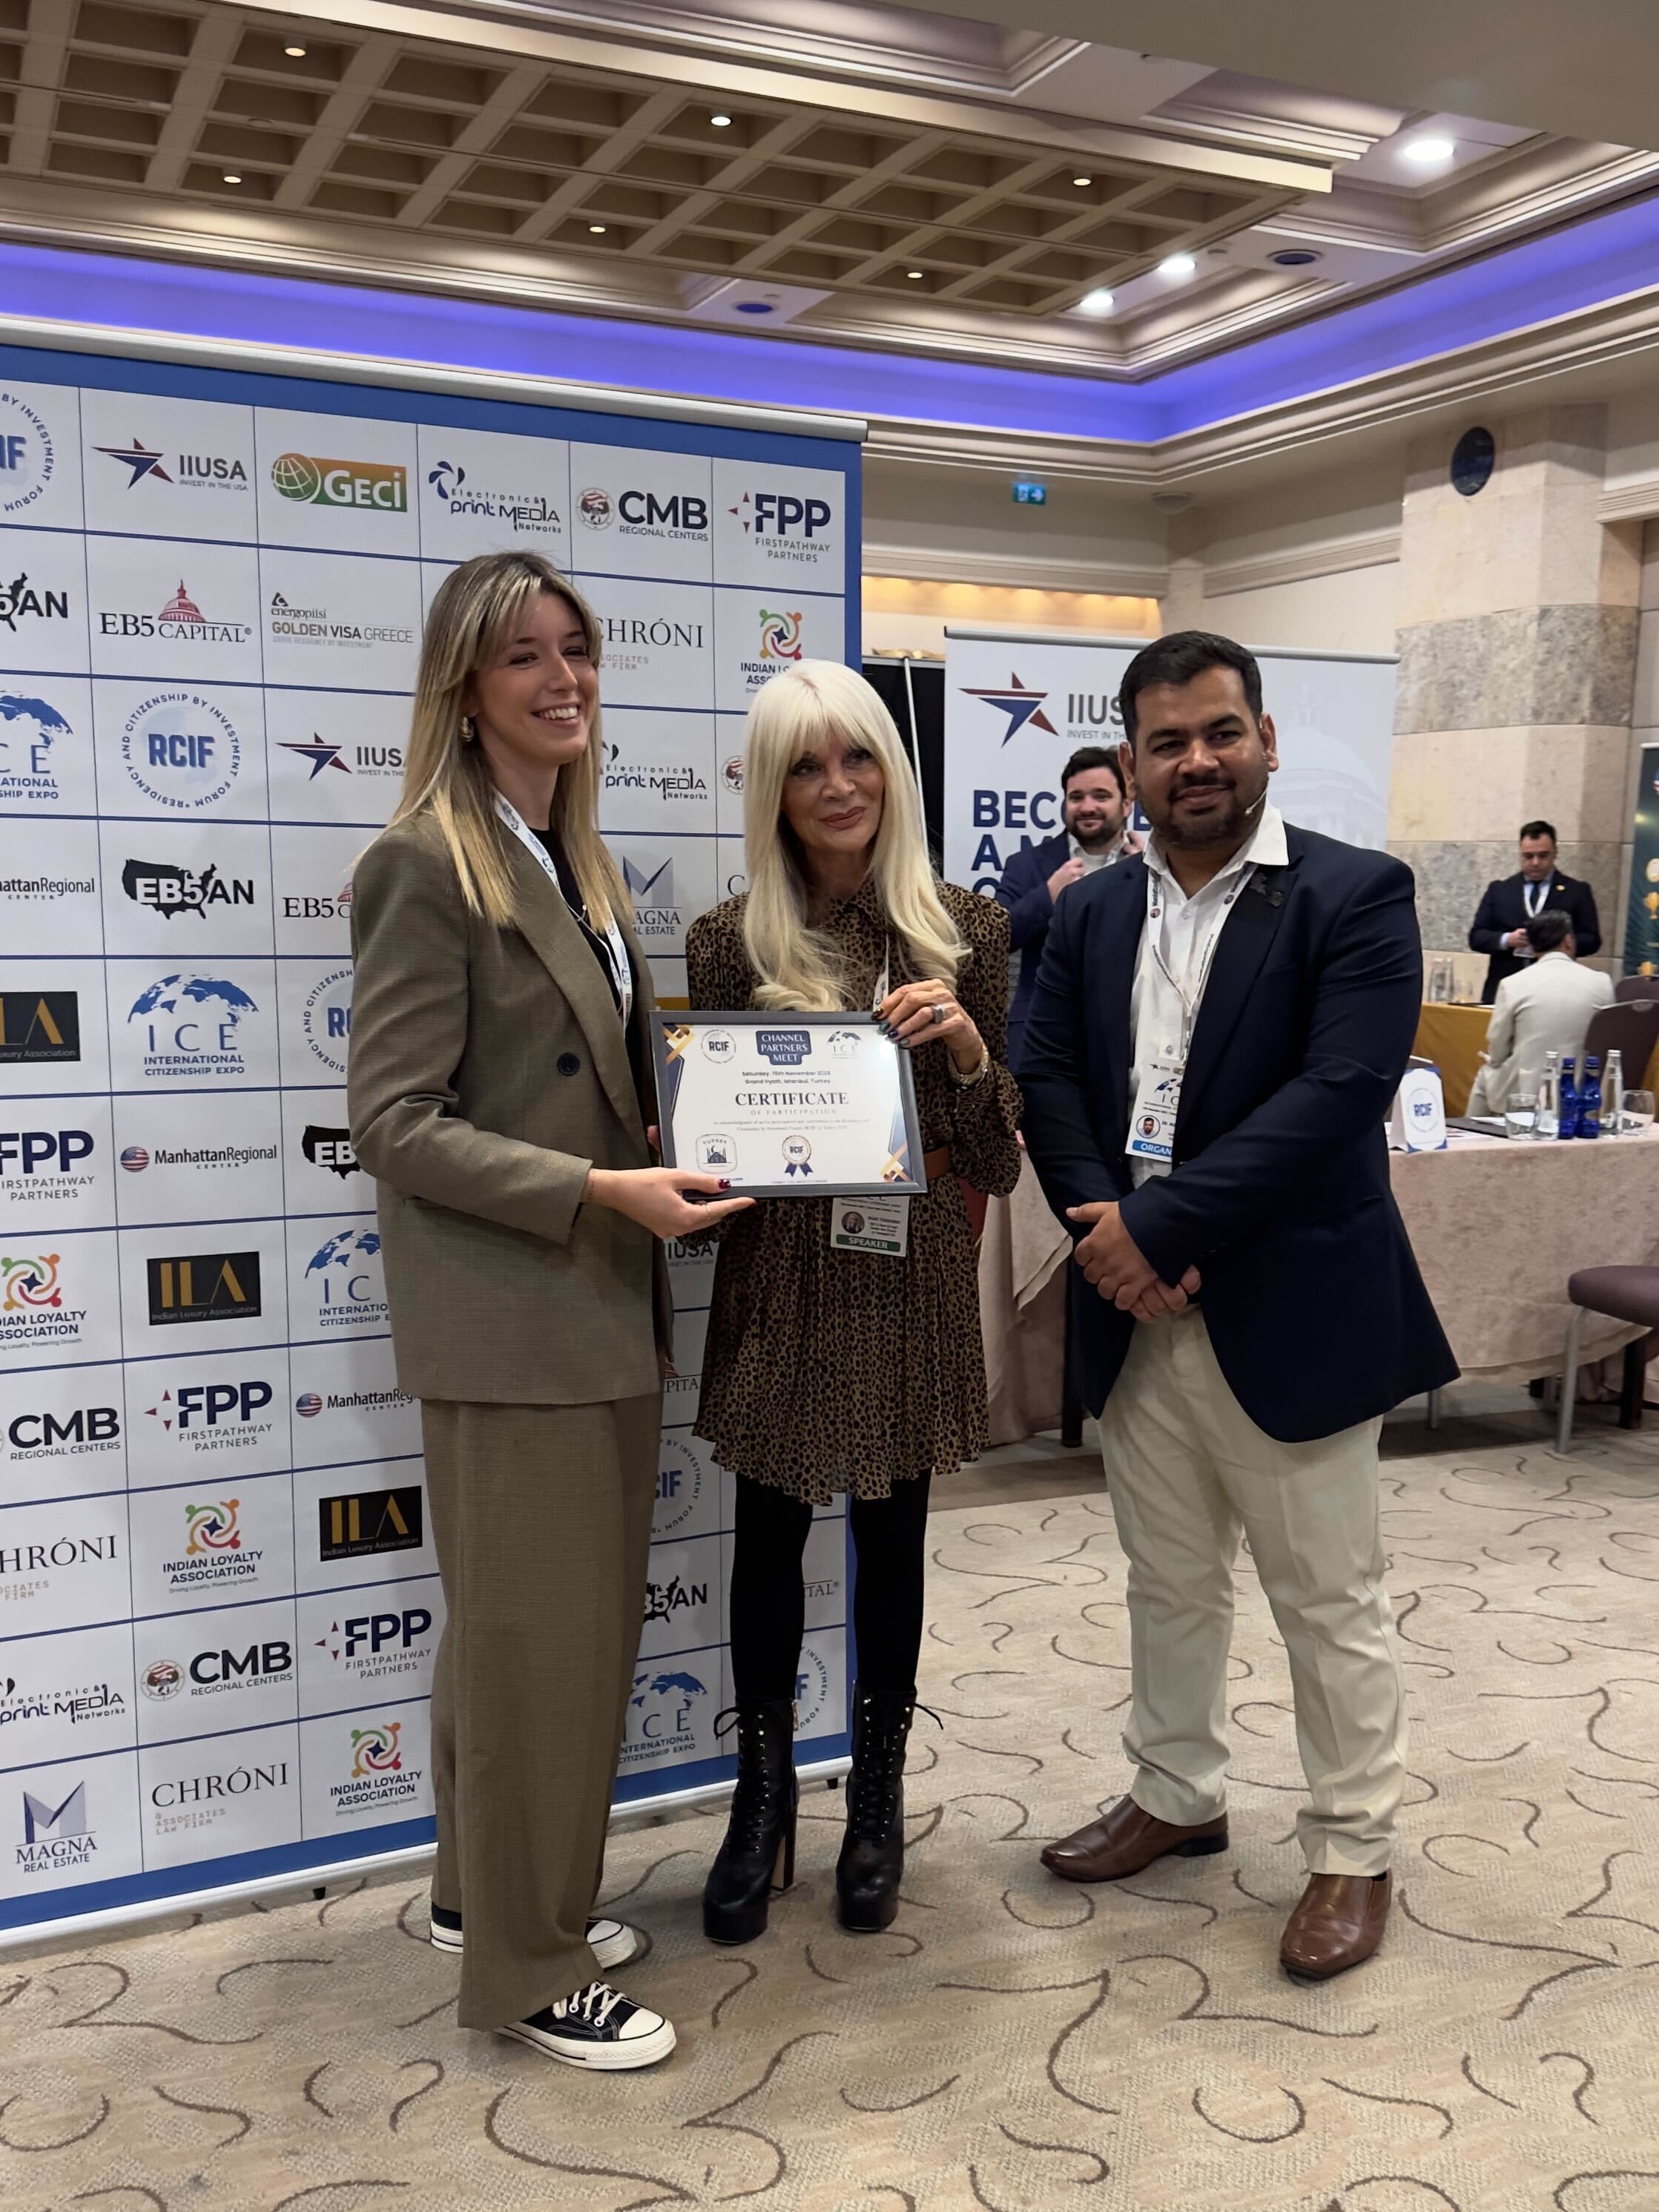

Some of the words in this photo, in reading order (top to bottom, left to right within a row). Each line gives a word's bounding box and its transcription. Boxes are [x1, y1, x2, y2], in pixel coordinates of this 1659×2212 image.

[1, 393, 19, 406] BY
[0, 434, 27, 470] IF
[21, 404, 54, 481] INVESTMENT
[179, 455, 248, 481] IIUSA
[179, 478, 205, 488] INVEST
[218, 481, 232, 490] THE
[234, 483, 248, 491] USA
[4, 485, 44, 512] FORUM
[452, 487, 530, 504] Electronic
[534, 495, 541, 504] &
[451, 499, 495, 517] print
[619, 490, 708, 530] CMB
[755, 493, 831, 538] FPP
[518, 522, 561, 534] Networks
[619, 525, 666, 538] REGIONAL
[668, 530, 708, 542] CENTERS
[755, 537, 831, 553] FIRSTPATHWAY
[767, 550, 818, 563] PARTNERS
[0, 590, 69, 619] 5AN
[99, 612, 154, 637] EB5
[272, 621, 328, 637] GOLDEN
[330, 625, 362, 640] VISA
[364, 628, 415, 644] GREECE
[600, 617, 705, 648] HRÓNI
[741, 662, 776, 674] INDIAN
[193, 696, 208, 708] BY
[1068, 694, 1124, 725] IIUS
[125, 694, 188, 733] CITIZENSHIP
[210, 706, 241, 778] INVESTMENT
[1067, 730, 1098, 740] INVEST
[1102, 731, 1111, 740] IN
[122, 736, 131, 760] AND
[148, 733, 216, 768] RCIF
[357, 746, 405, 768] IIUS
[606, 763, 678, 774] Electronic
[0, 777, 59, 789] ATIONAL
[126, 765, 184, 808] RESIDENCY
[605, 774, 647, 789] print
[28, 790, 59, 800] EXPO
[194, 781, 231, 807] FORUM
[667, 791, 708, 800] Networks
[135, 877, 255, 904] EB5AN
[282, 897, 334, 918] EB5
[633, 910, 682, 925] AGNA
[645, 926, 676, 935] ESTATE
[306, 969, 352, 1007] CITIZENSH
[303, 1010, 312, 1033] AND
[148, 1024, 238, 1053] ICE
[708, 1041, 729, 1053] RCIF
[762, 1034, 805, 1042] CHANNEL
[24, 1050, 77, 1058] Association
[761, 1044, 808, 1053] PARTNERS
[773, 1053, 798, 1062] MEET
[145, 1055, 245, 1065] INTERNATIONAL
[145, 1066, 211, 1076] CITIZENSHIP
[217, 1066, 245, 1074] EXPO
[735, 1092, 849, 1106] CERTIFICATE
[0, 1130, 94, 1175] FPP
[1140, 1142, 1172, 1156] ORGAN
[1, 1176, 95, 1189] IRSTPATHWAY
[10, 1188, 79, 1201] PARTNERS
[667, 1241, 713, 1260] IUSA
[848, 1237, 889, 1249] SPEAKER
[160, 1259, 247, 1309] ILA
[324, 1274, 371, 1304] IC
[30, 1310, 87, 1325] LOYALTY
[180, 1310, 207, 1318] Luxury
[209, 1306, 257, 1315] Association
[320, 1303, 388, 1317] INTERNATIO
[320, 1314, 380, 1327] CITIZENSHIP
[0, 1324, 79, 1340] SSOCIATION
[664, 1377, 699, 1394] PITA
[178, 1381, 273, 1429] FPP
[9, 1407, 120, 1449] CMB
[179, 1423, 273, 1442] FIRSTPATHWAY
[10, 1446, 68, 1461] REGIONAL
[70, 1441, 121, 1455] CENTERS
[194, 1435, 257, 1452] PARTNERS
[679, 1444, 702, 1500] INVESTMENT
[332, 1494, 409, 1544] ILA
[665, 1504, 693, 1530] FORUM
[0, 1535, 117, 1574] HRÓNI
[322, 1546, 346, 1557] Indian
[348, 1542, 373, 1554] Luxury
[375, 1537, 419, 1550] Association
[163, 1558, 208, 1573] INDIAN
[211, 1550, 263, 1567] LOYALTY
[171, 1564, 256, 1584] ASSOCIATION
[345, 1608, 432, 1657] FPP
[189, 1641, 292, 1685] CMB
[345, 1649, 432, 1670] FIRSTPATHWAY
[360, 1662, 418, 1679] PARTNERS
[805, 1649, 829, 1702] INVESTMENT
[191, 1680, 244, 1696] REGIONAL
[246, 1673, 293, 1689] CENTERS
[1, 1688, 88, 1706] Electronic
[0, 1703, 50, 1725] print
[76, 1708, 125, 1721] Networks
[800, 1706, 819, 1728] FORU
[621, 1734, 695, 1754] NTERNATIONAL
[673, 1743, 696, 1754] EXPO
[152, 1762, 289, 1807] CHRÓNI
[330, 1780, 372, 1797] INDIAN
[375, 1770, 422, 1788] LOYALTY
[337, 1784, 415, 1808] ASSOCIATION
[155, 1808, 226, 1826] ASSOCIATES
[155, 1825, 177, 1836] LAW
[184, 1819, 213, 1830] FIRM
[16, 1836, 98, 1865] MAGNA
[24, 1860, 52, 1874] REAL
[53, 1853, 90, 1869] ESTATE
